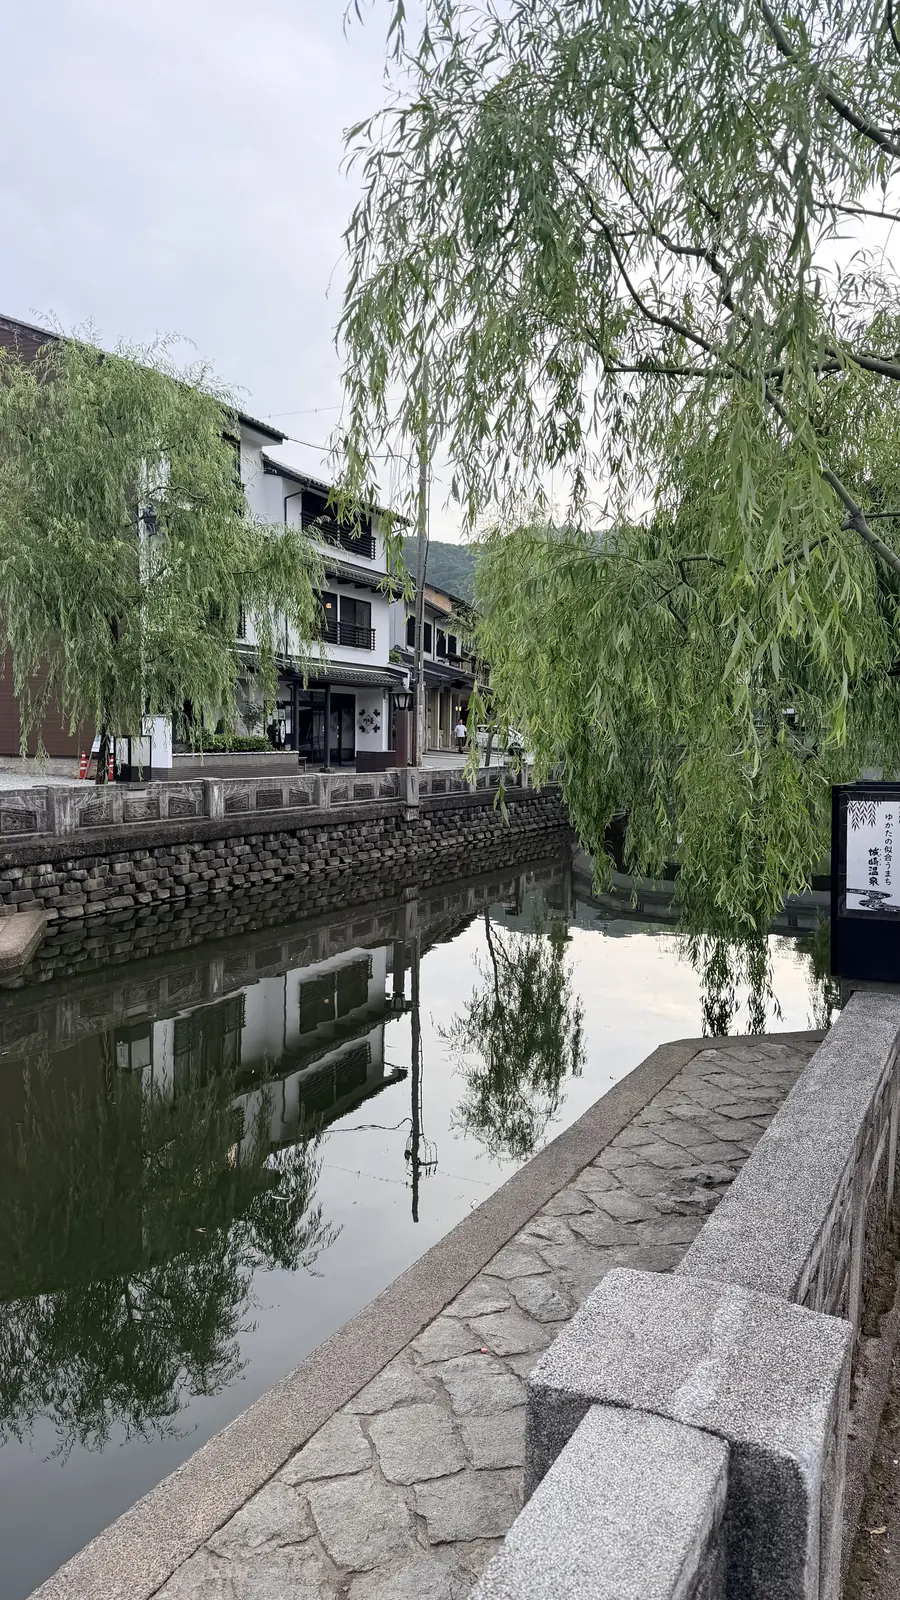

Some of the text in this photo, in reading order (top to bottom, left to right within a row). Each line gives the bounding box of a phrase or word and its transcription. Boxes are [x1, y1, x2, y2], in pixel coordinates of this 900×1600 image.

[868, 847, 880, 886] 城崎温泉
[884, 813, 894, 886] ゆかたの似合うまち
